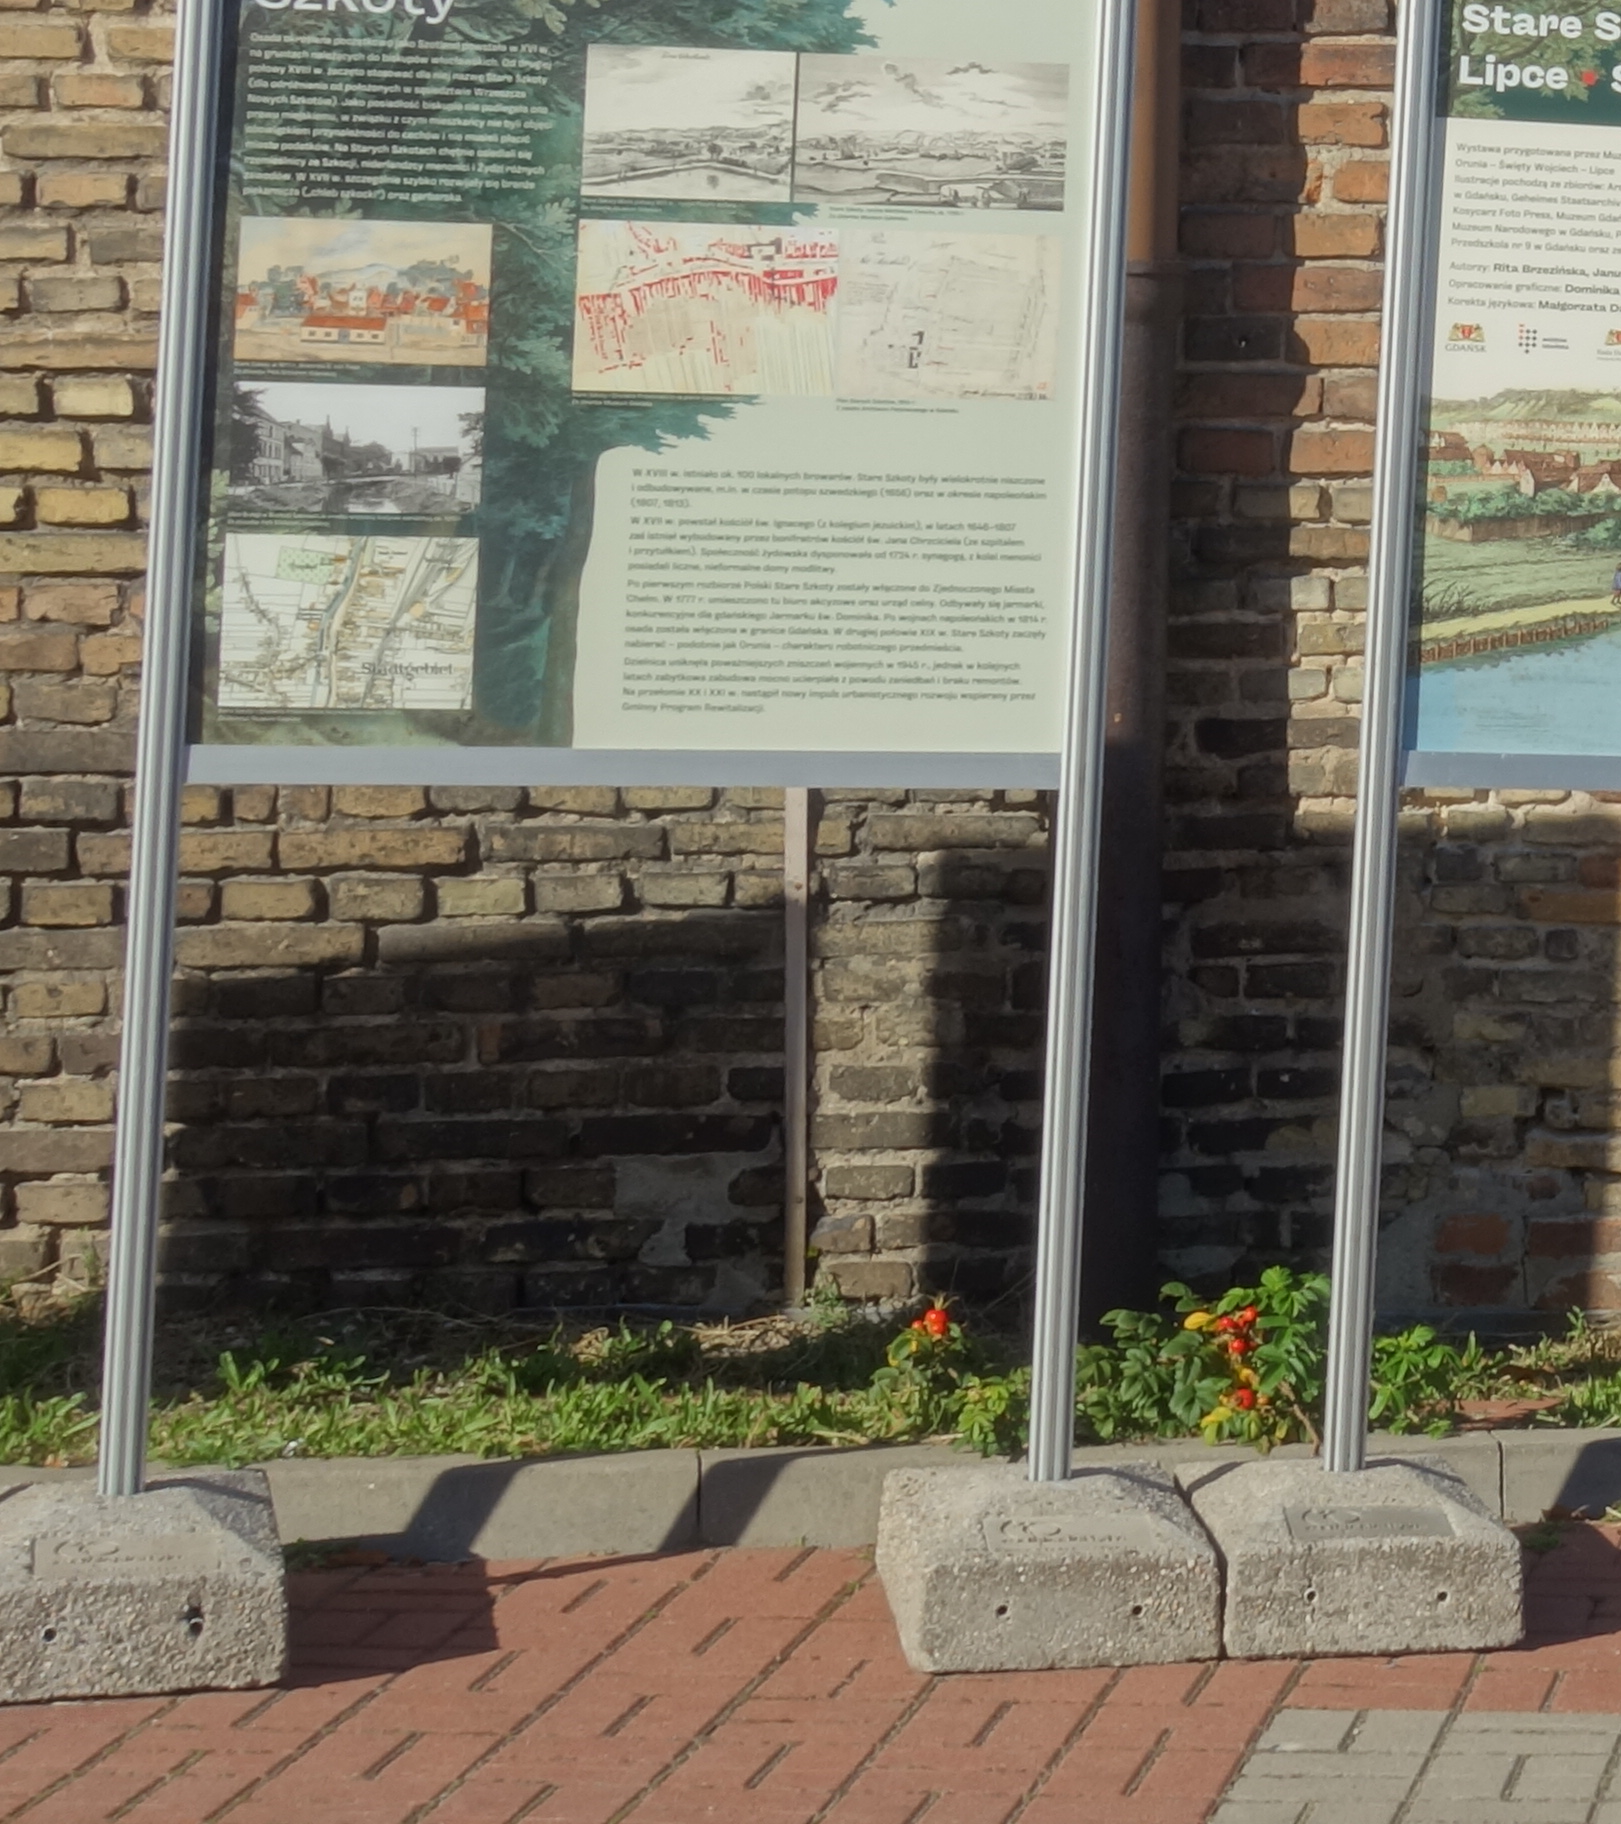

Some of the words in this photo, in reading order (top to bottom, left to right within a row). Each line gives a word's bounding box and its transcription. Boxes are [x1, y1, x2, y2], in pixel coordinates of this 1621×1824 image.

[1462, 3, 1582, 38] Stare
[1458, 54, 1569, 93] Lipce
[1456, 143, 1501, 154] Wystawa
[1503, 147, 1572, 157] przygotowana
[1573, 150, 1601, 159] przez
[1455, 158, 1488, 169] Orunia
[1498, 159, 1532, 173] Święty
[1534, 163, 1578, 174] Wojciech
[1588, 166, 1616, 176] Lipce
[1454, 175, 1500, 187] Ilustracje
[1502, 178, 1548, 189] pochodzą
[1550, 181, 1562, 189] ze
[1563, 180, 1605, 190] zbiorów:
[1464, 190, 1509, 202] Gdańsku,
[1560, 195, 1621, 207] Staatsarchiv
[1452, 206, 1497, 217] Kosycarz
[1499, 208, 1522, 218] Foto
[1556, 211, 1596, 221] Muzeum
[1452, 222, 1493, 232] Muzeum
[1494, 224, 1556, 237] Narodowego
[1569, 227, 1613, 239] Gdańsku,
[1451, 237, 1510, 249] Przedszkola
[1544, 242, 1586, 253] Gdańsku
[1588, 246, 1610, 254] oraz
[1493, 263, 1519, 273] Rita
[1522, 264, 1590, 278] Brzezińska,
[1448, 279, 1513, 290] Opracowanie
[1564, 283, 1620, 295] Dominika
[1448, 297, 1486, 306] Korekta
[1538, 300, 1607, 312] Małgorzata
